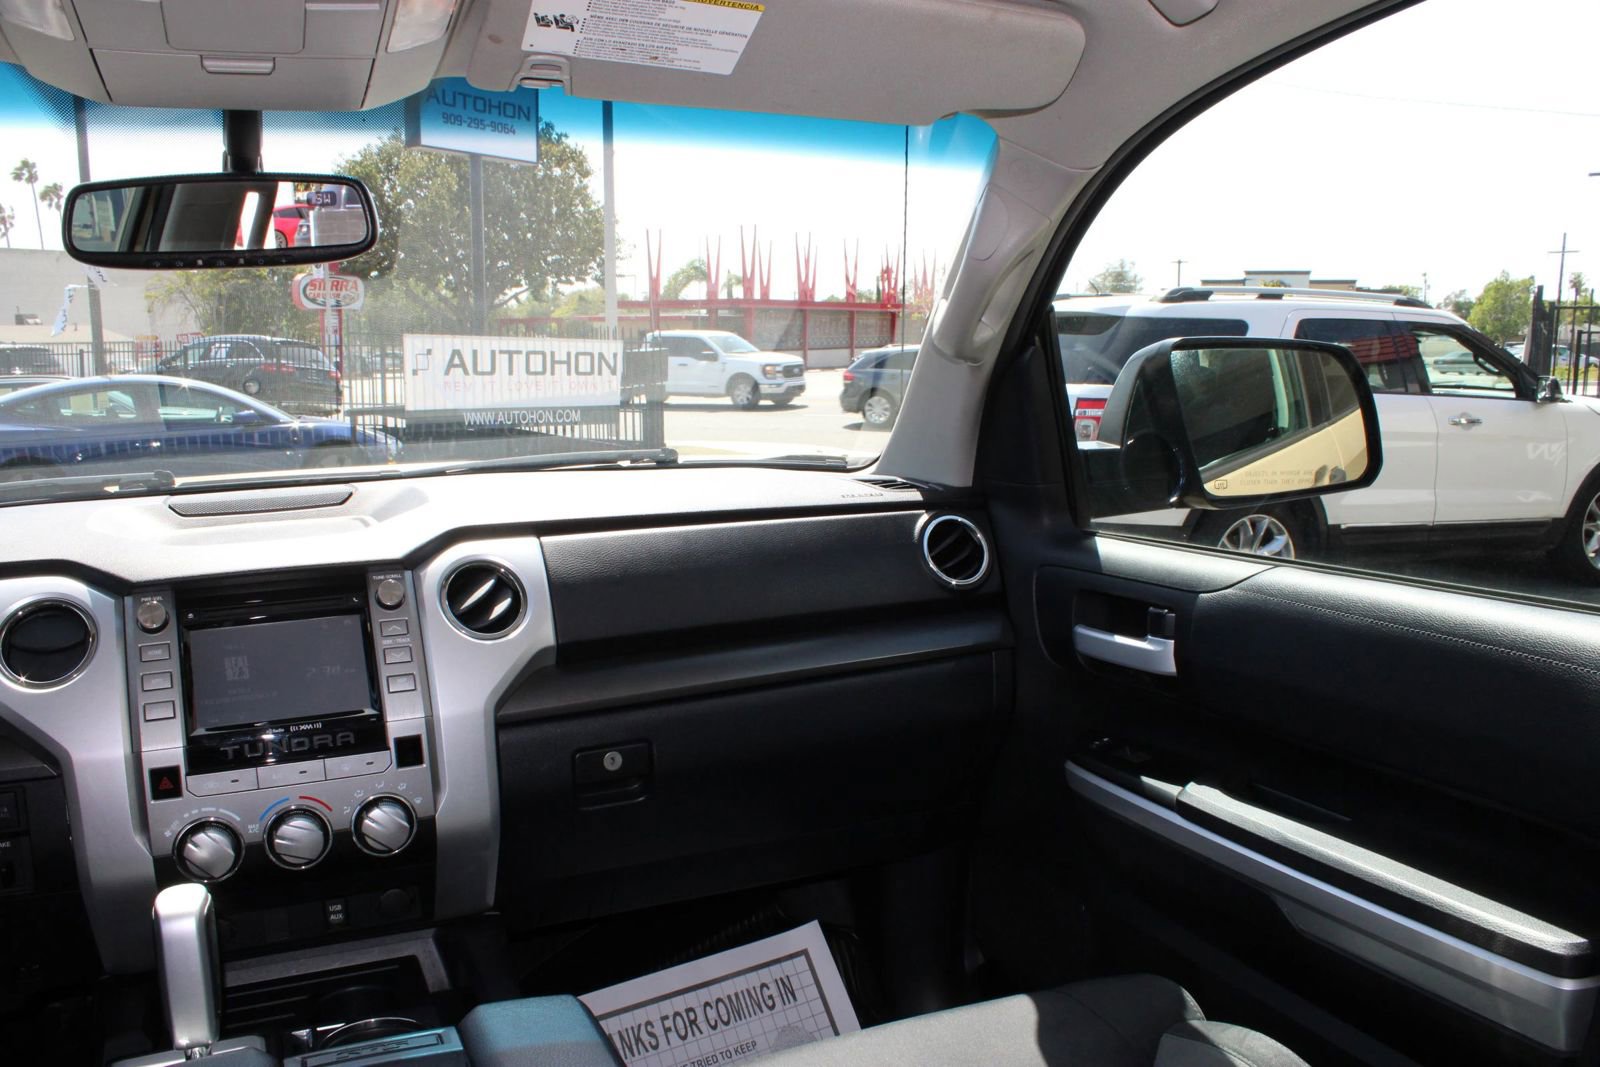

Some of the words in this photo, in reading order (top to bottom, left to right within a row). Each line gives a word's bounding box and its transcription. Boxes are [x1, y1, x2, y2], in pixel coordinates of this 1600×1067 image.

[426, 87, 531, 121] AUTOHON
[441, 111, 516, 135] 909-295-9064
[309, 279, 358, 291] SIRRA
[444, 349, 617, 376] AUTOHON
[463, 409, 582, 426] WWW.AUTOHON.COM
[219, 731, 356, 761] TUNDRA
[608, 1019, 660, 1060] NKS
[660, 1007, 704, 1046] FOR
[703, 982, 776, 1031] COMING
[774, 974, 798, 1007] IN
[689, 1054, 719, 1067] TRIED
[719, 1049, 732, 1061] TO
[733, 1040, 757, 1057] KEEP
